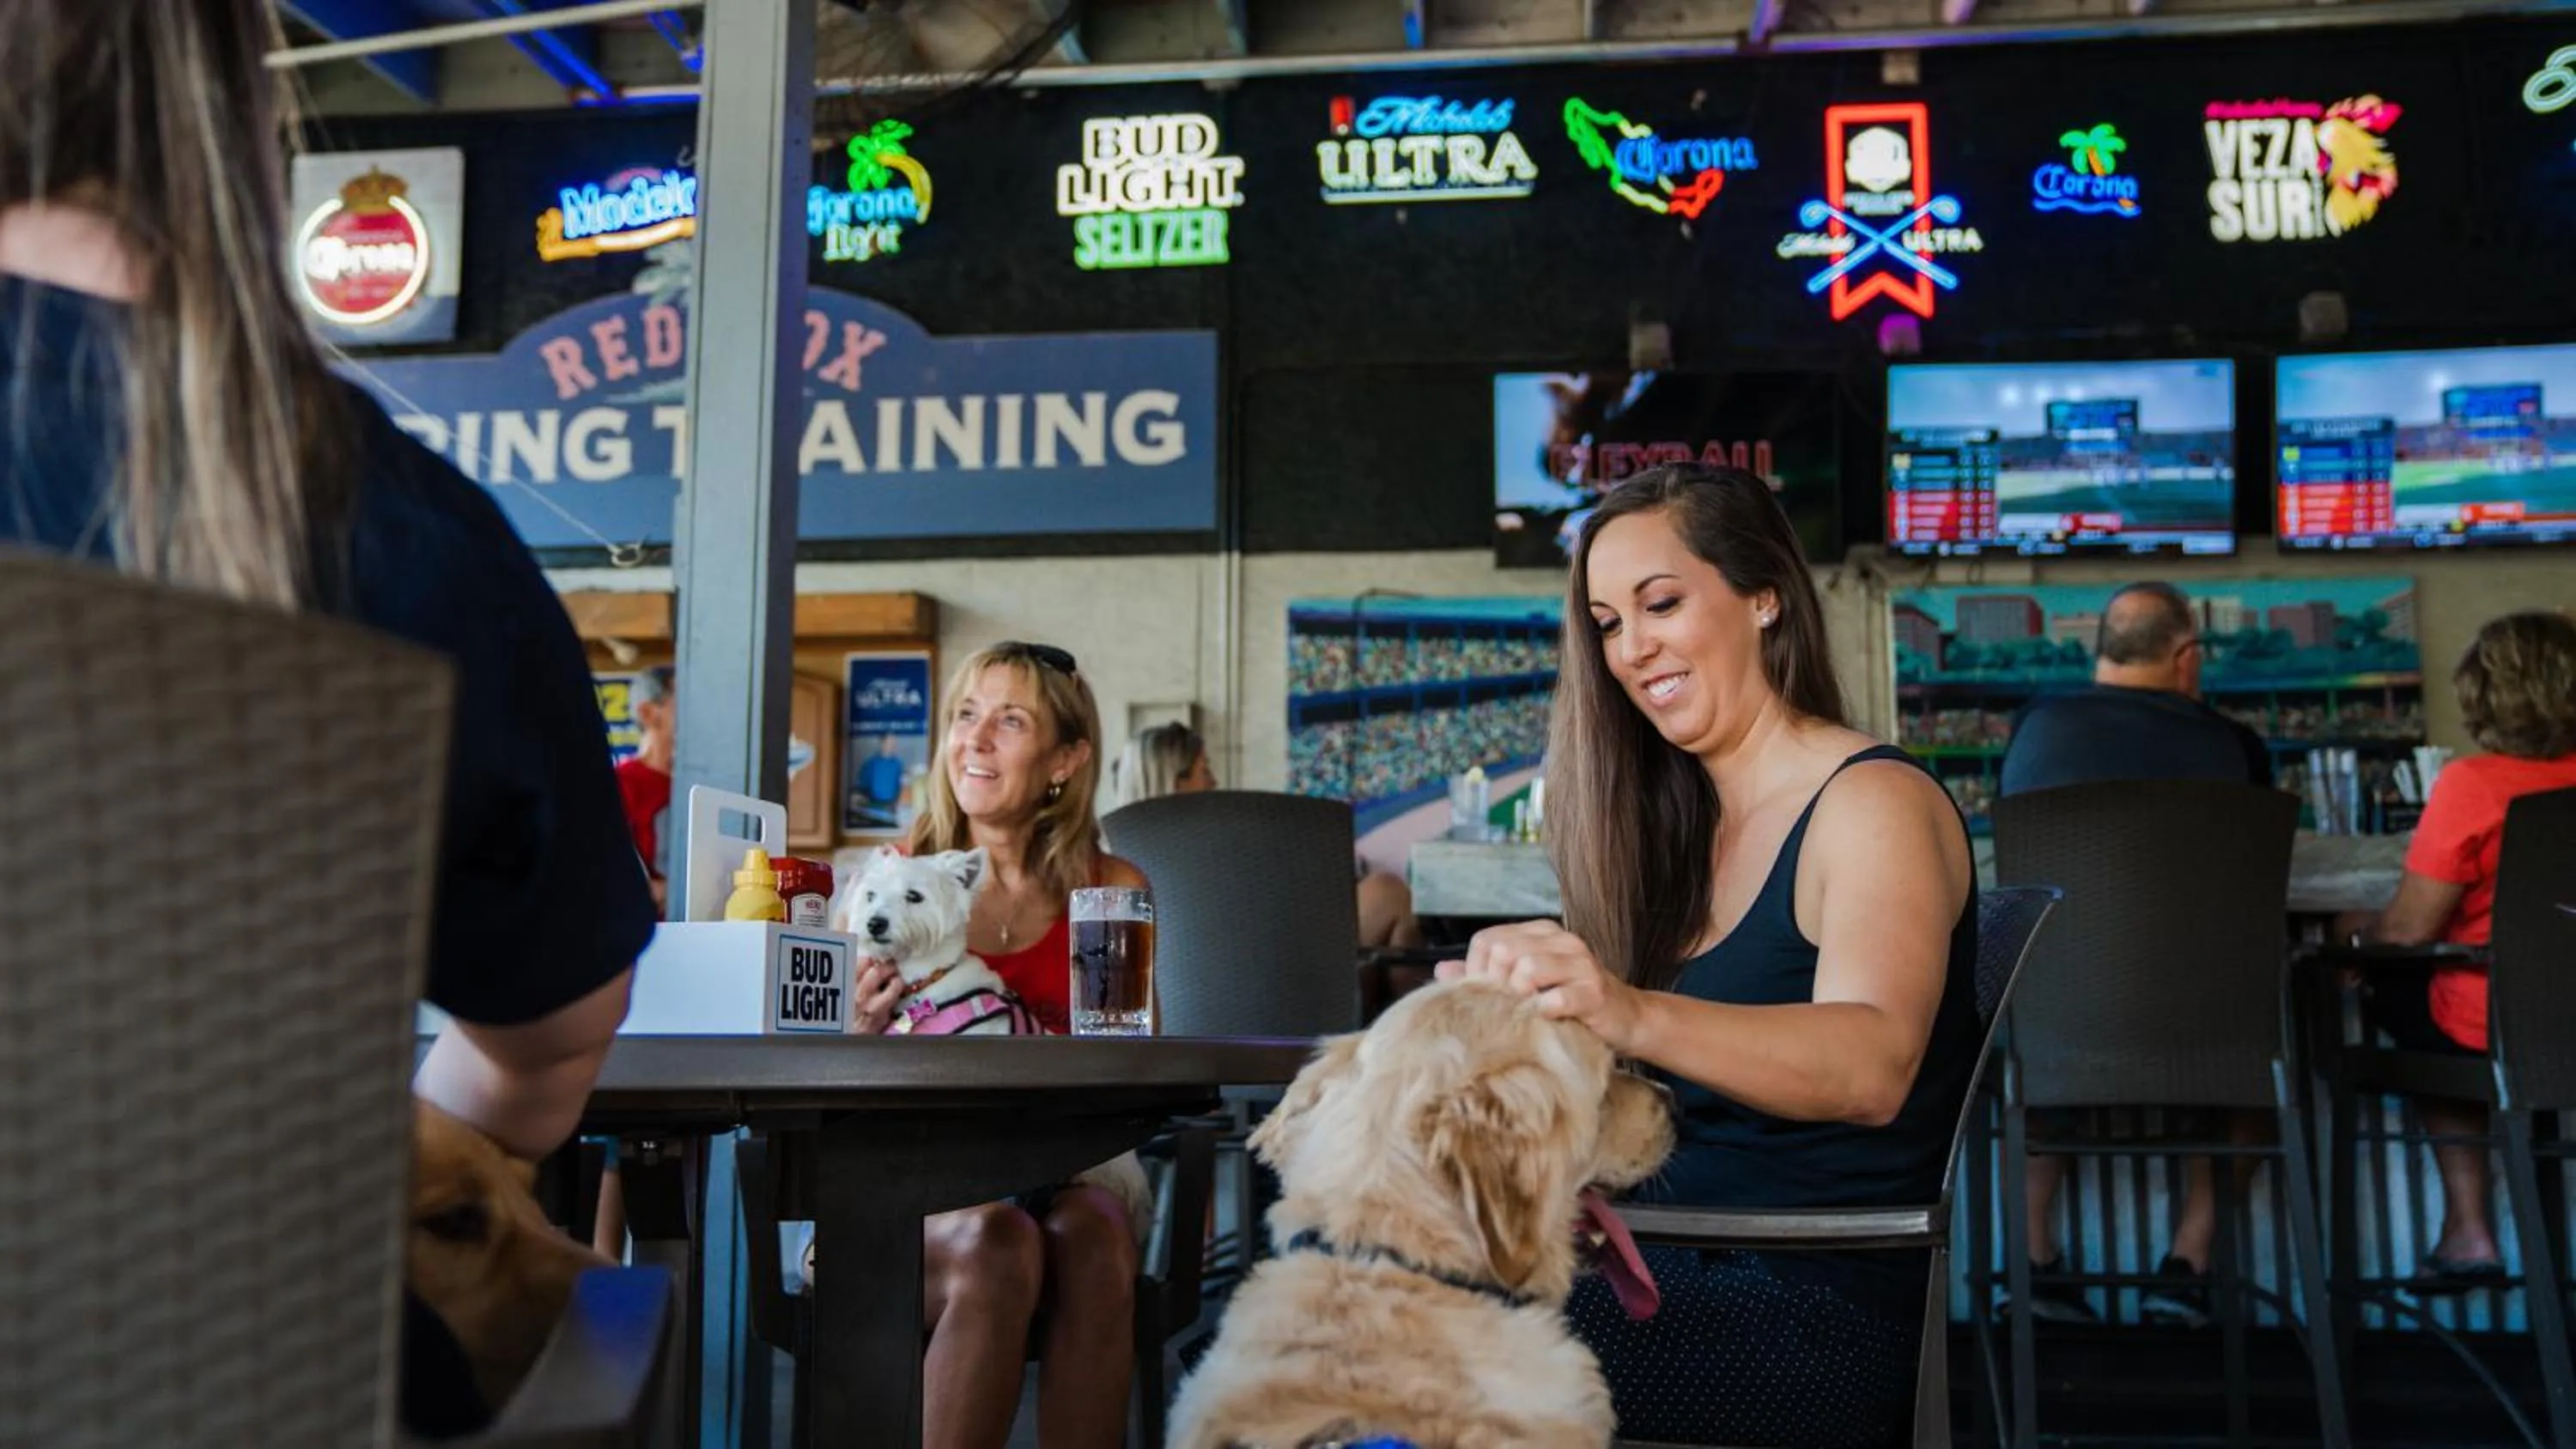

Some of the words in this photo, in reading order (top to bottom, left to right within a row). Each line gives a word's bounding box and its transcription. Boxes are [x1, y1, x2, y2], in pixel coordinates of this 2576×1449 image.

[1083, 112, 1218, 168] BUD
[1317, 131, 1539, 189] ULTRA
[1613, 134, 1758, 184] Corona
[2204, 118, 2319, 179] VEZA
[1057, 155, 1244, 216] LIGHT
[2033, 164, 2139, 198] Corona
[2207, 179, 2316, 242] SUR
[307, 235, 416, 282] Corona
[1073, 209, 1230, 270] SELTZER
[1901, 227, 1984, 252] ULTRA
[539, 304, 683, 400] RED
[791, 947, 833, 984] BUD
[781, 985, 840, 1022] LIGHT
